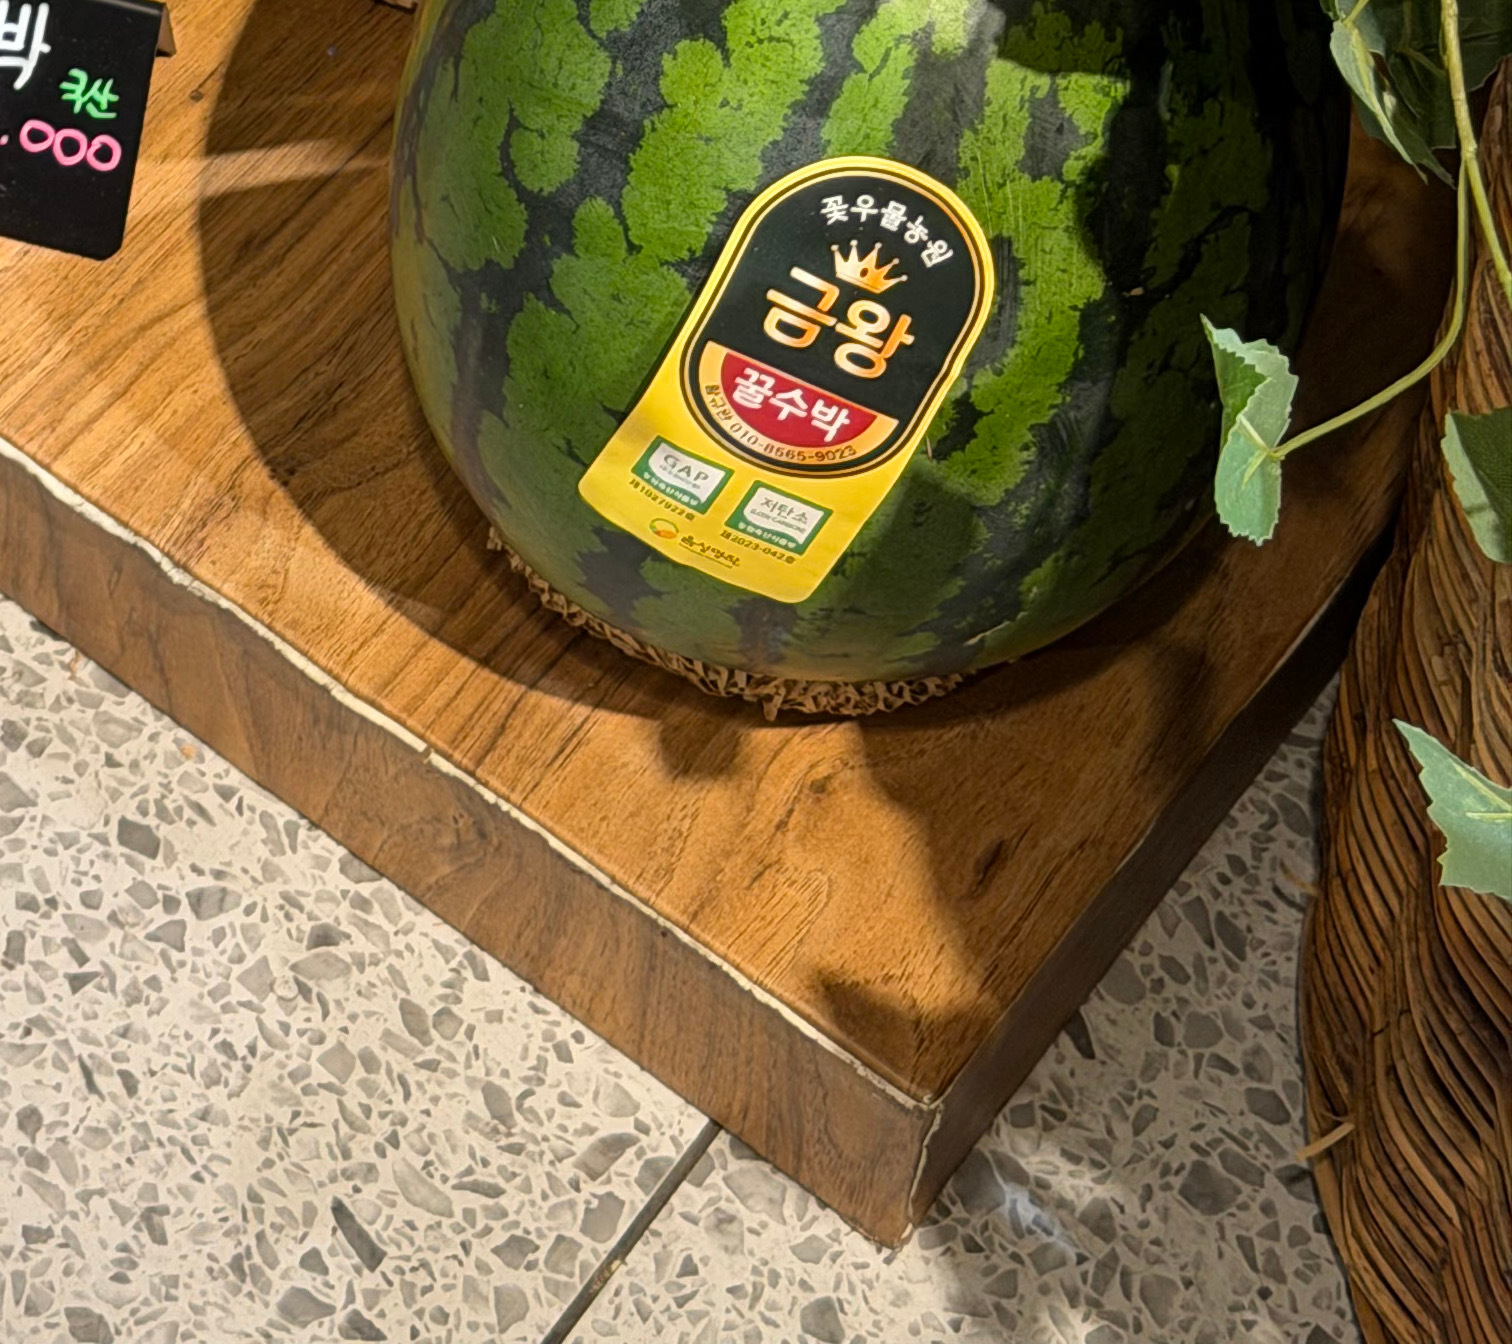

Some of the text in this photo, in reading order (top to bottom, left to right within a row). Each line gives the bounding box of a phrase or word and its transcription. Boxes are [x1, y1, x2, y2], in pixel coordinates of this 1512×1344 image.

[59, 68, 120, 119] 국산
[820, 194, 953, 268] 꽃우물농원
[763, 267, 914, 379] 금왕
[732, 367, 851, 442] 꿀수박
[663, 454, 709, 482] GAP
[761, 496, 808, 525] 저탄소
